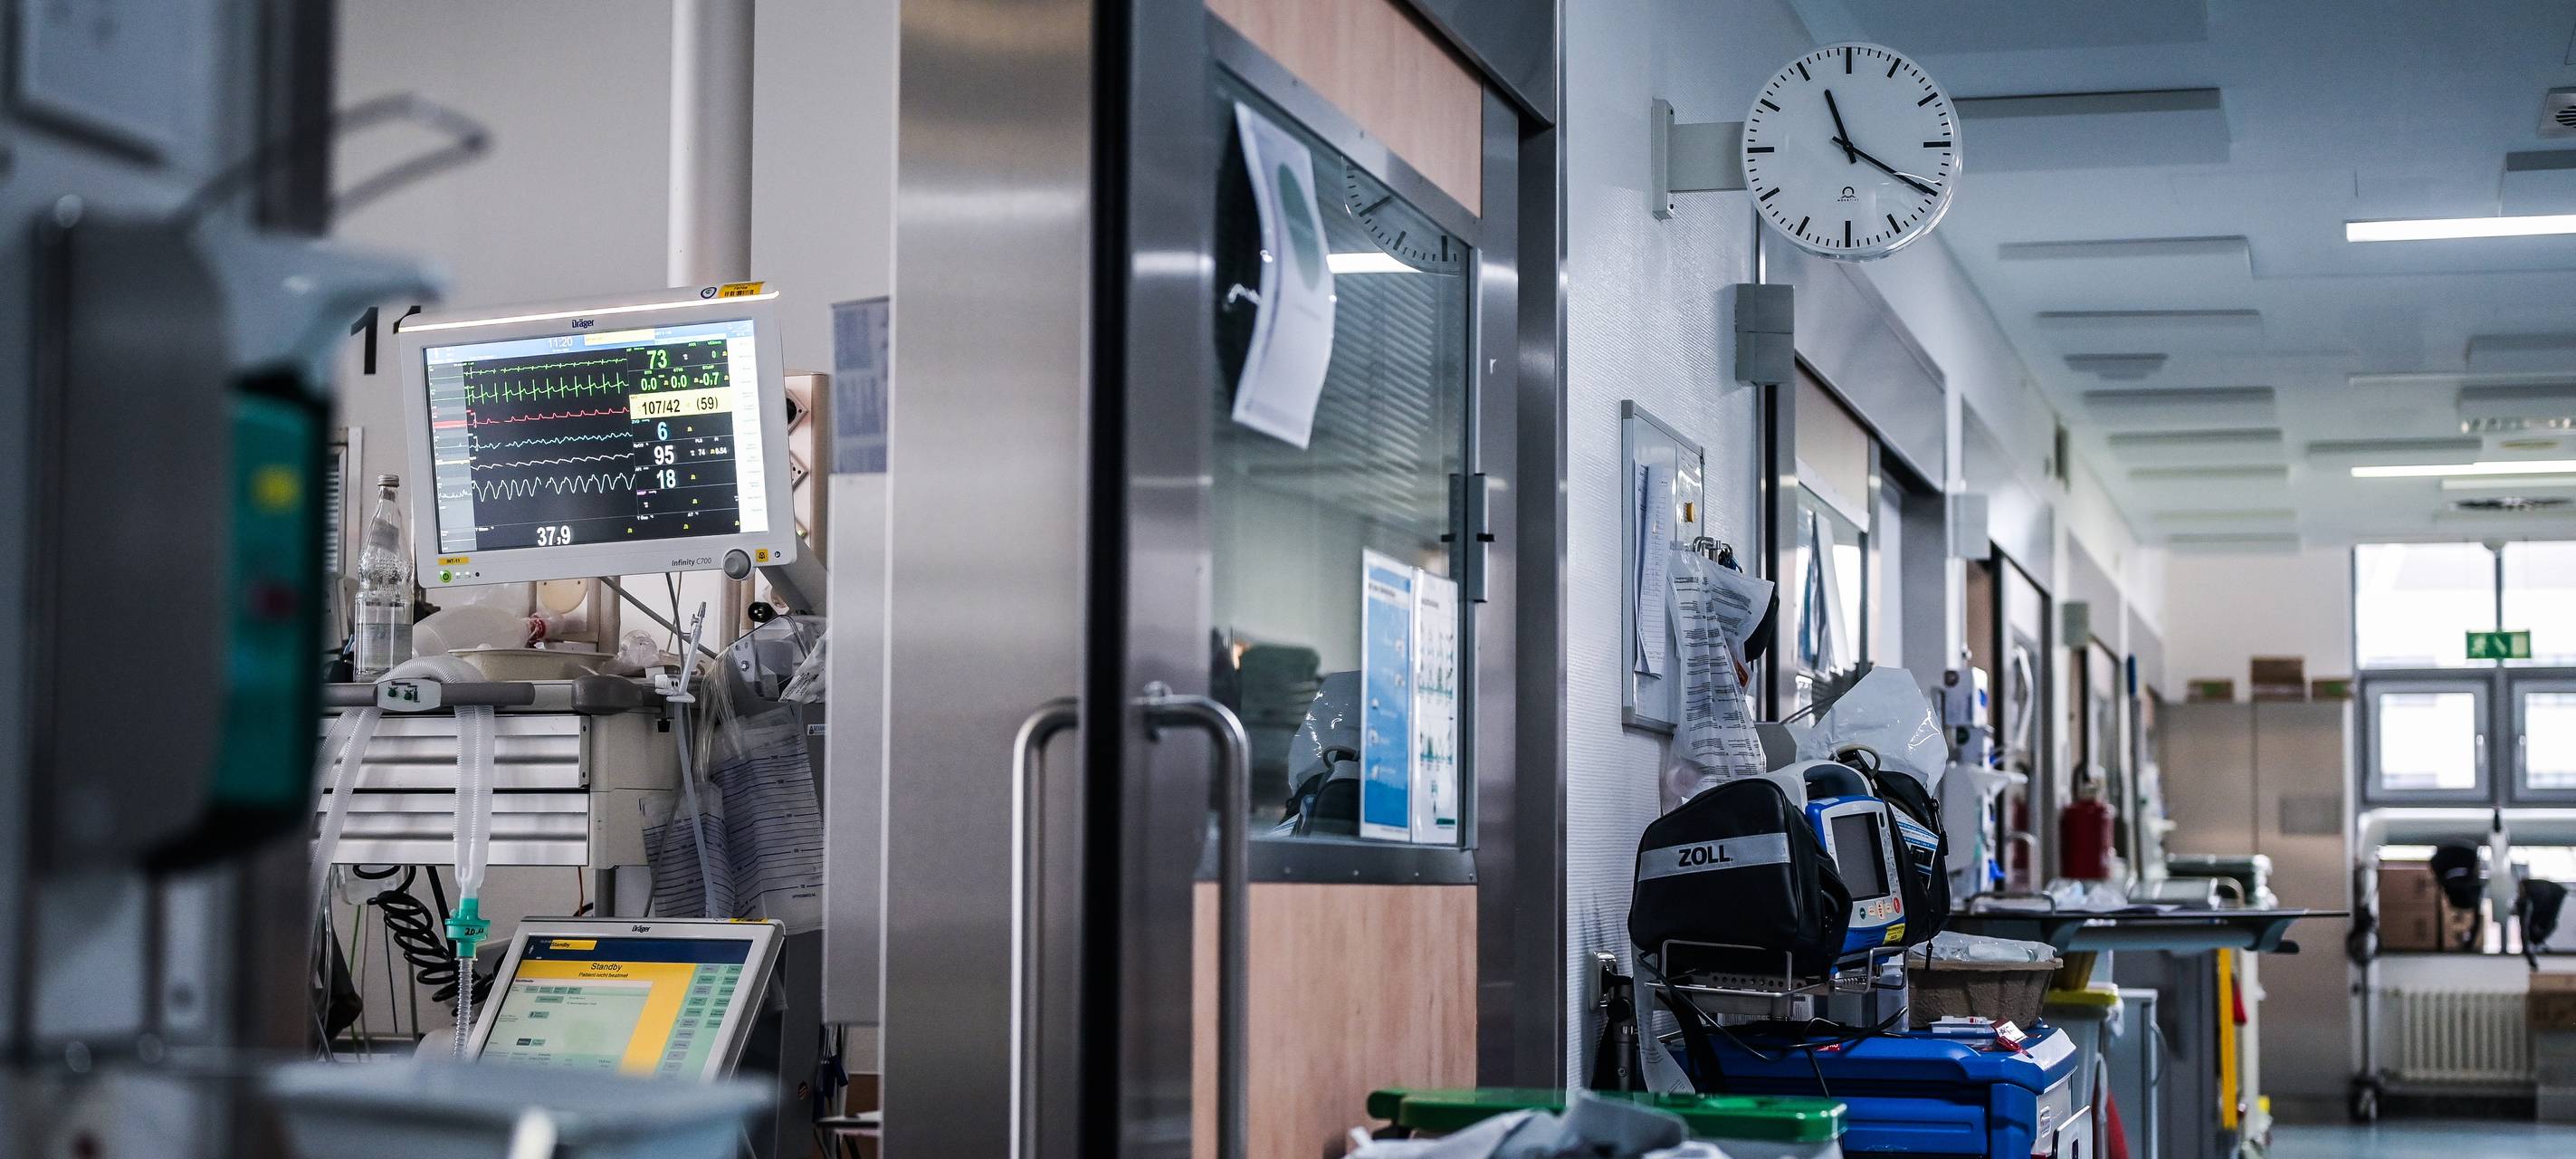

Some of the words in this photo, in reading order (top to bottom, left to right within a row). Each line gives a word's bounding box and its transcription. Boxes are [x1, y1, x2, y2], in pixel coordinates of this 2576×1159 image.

[571, 319, 595, 329] Dräger
[549, 337, 572, 348] 11:20
[647, 350, 668, 369] 73
[641, 378, 657, 391] 0,0
[671, 375, 688, 388] 0,0
[642, 398, 681, 415] 107/42
[696, 397, 719, 411] (59)
[657, 421, 668, 441] 6
[654, 445, 675, 465] 95
[656, 469, 676, 489] 18
[537, 525, 572, 546] 37,9
[672, 559, 695, 567] Infinity
[1678, 845, 1731, 867] ZOLL
[632, 924, 651, 933] Dräger
[591, 963, 623, 972] Standby
